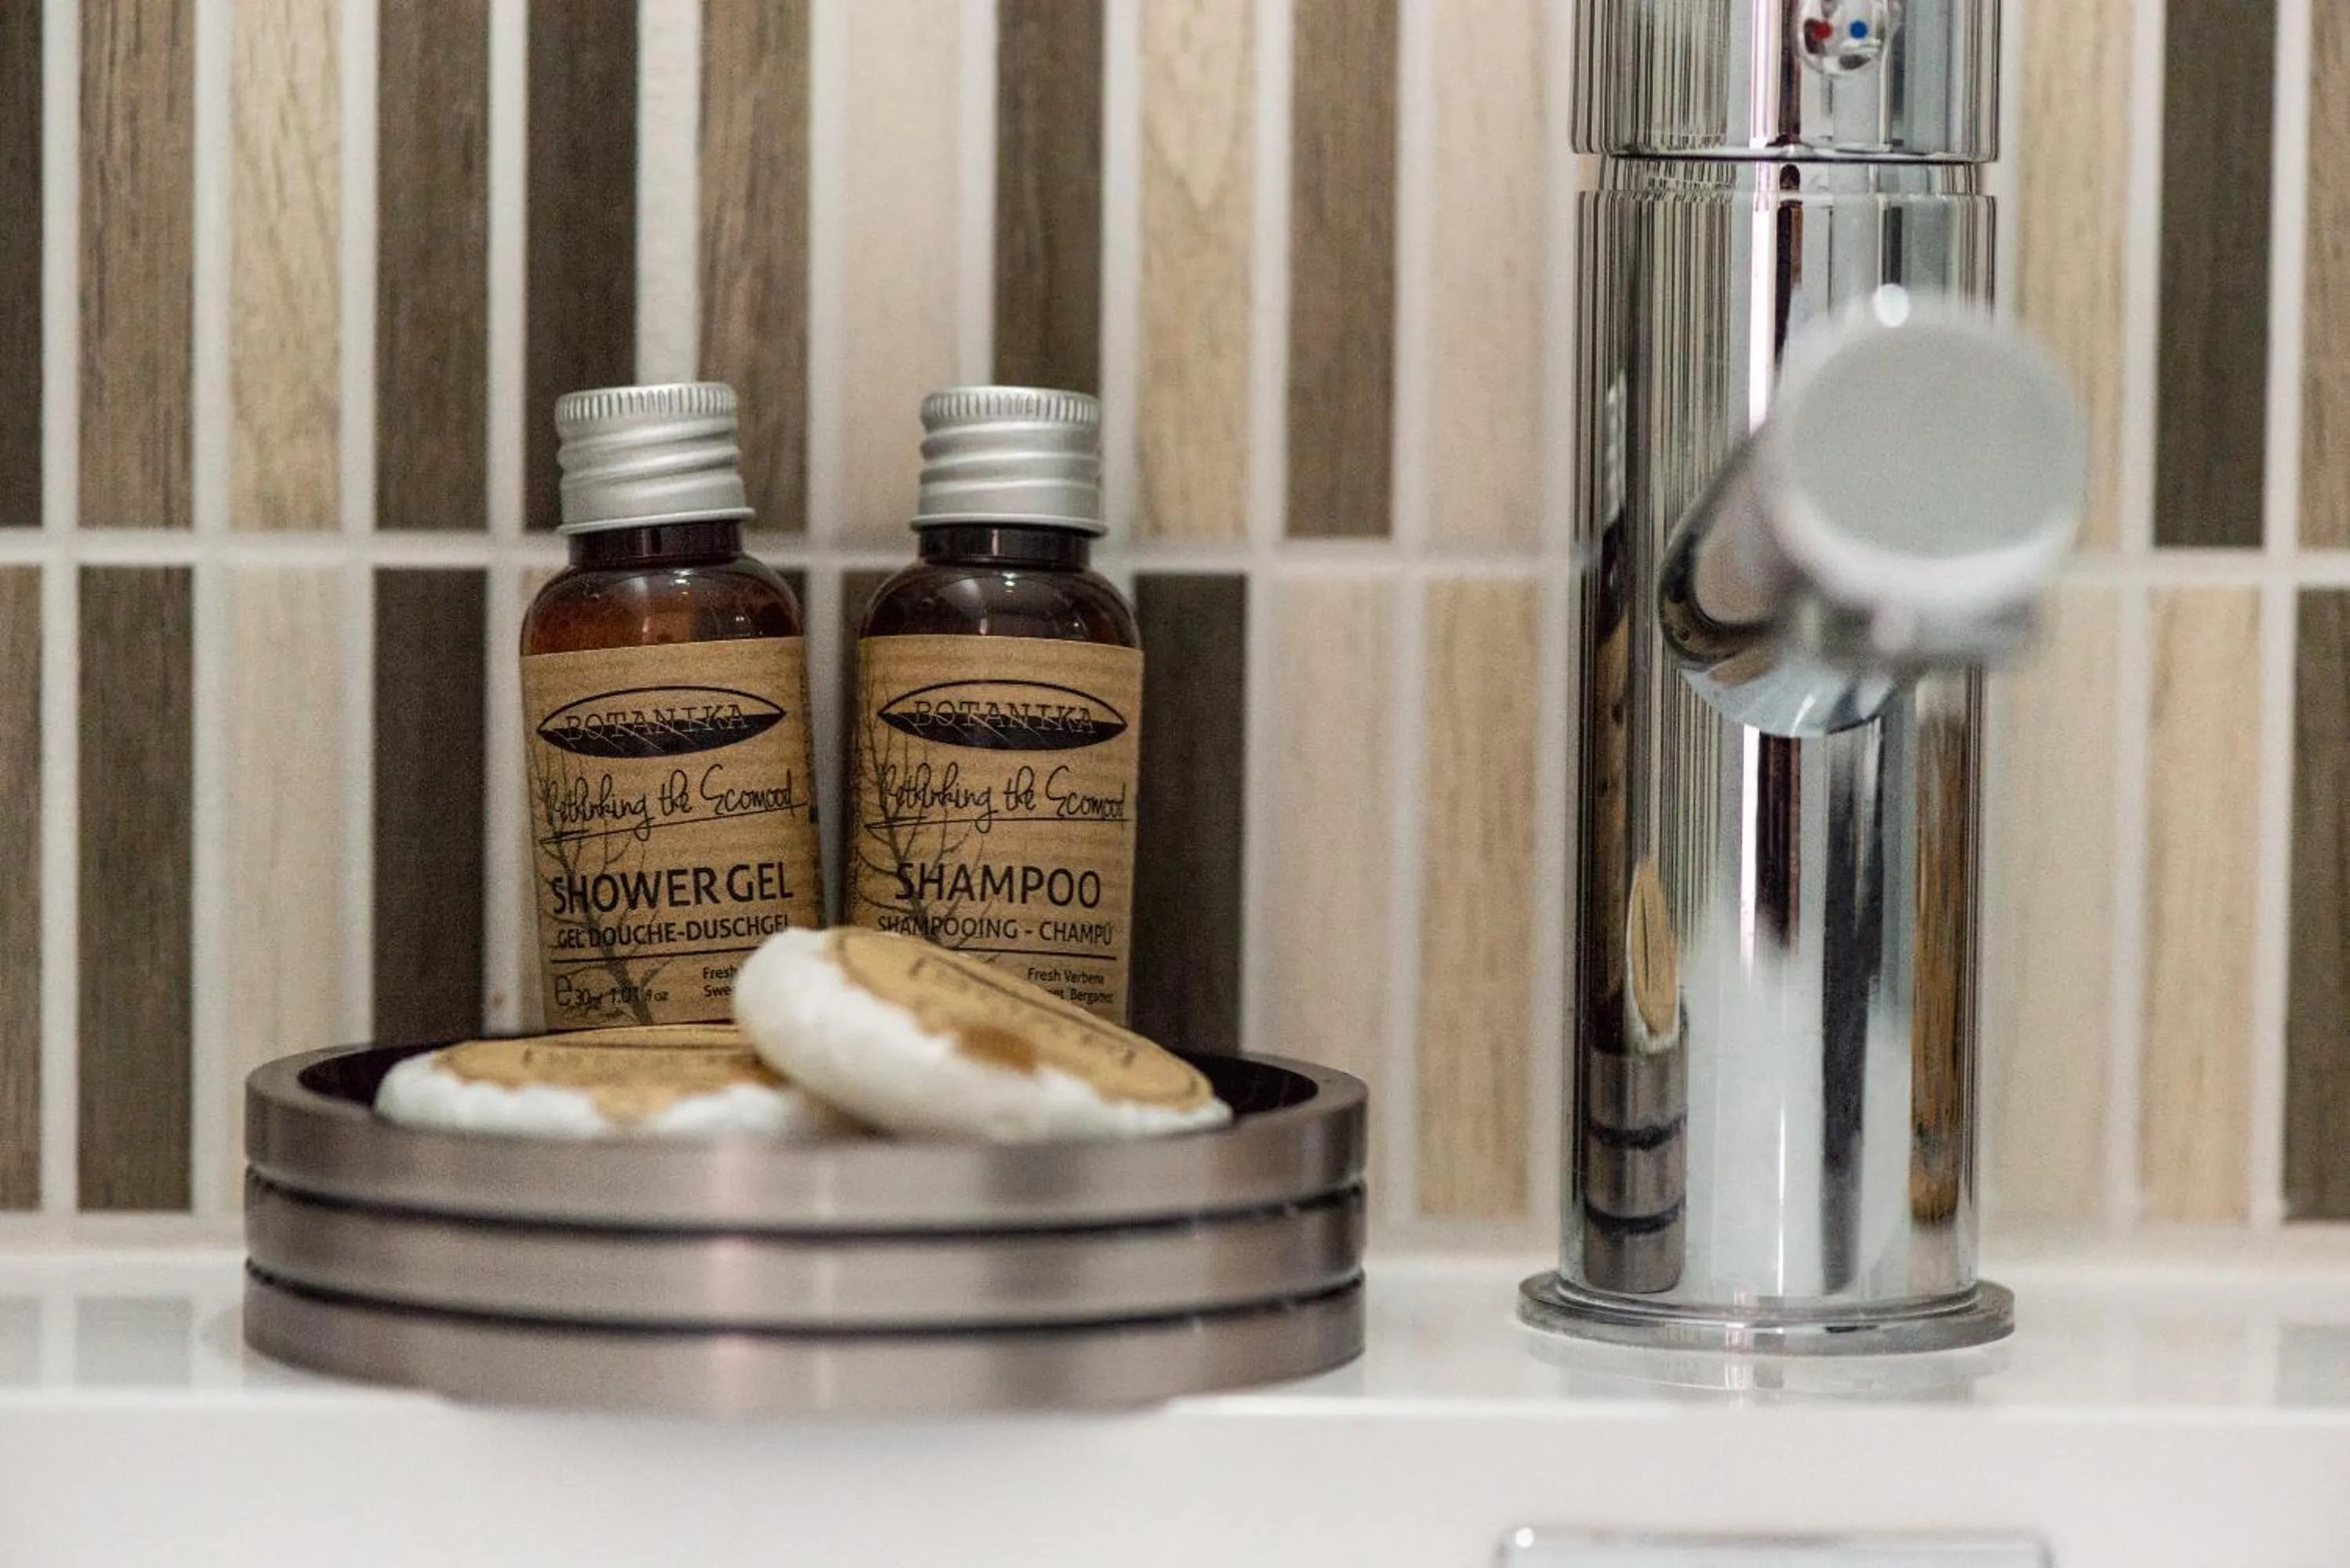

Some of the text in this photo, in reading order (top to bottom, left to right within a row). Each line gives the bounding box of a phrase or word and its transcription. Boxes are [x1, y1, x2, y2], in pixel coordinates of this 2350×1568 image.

[564, 704, 749, 741] BOTANIKA
[913, 701, 1097, 734] BOTANIKA
[658, 769, 692, 817] the
[1003, 765, 1037, 812] the
[552, 861, 795, 915] SHOWER GEL
[895, 862, 1101, 909] SHAMPOO
[557, 928, 586, 950] GEL
[877, 914, 1018, 940] SHAMPOOING
[1026, 966, 1061, 983] Fresh
